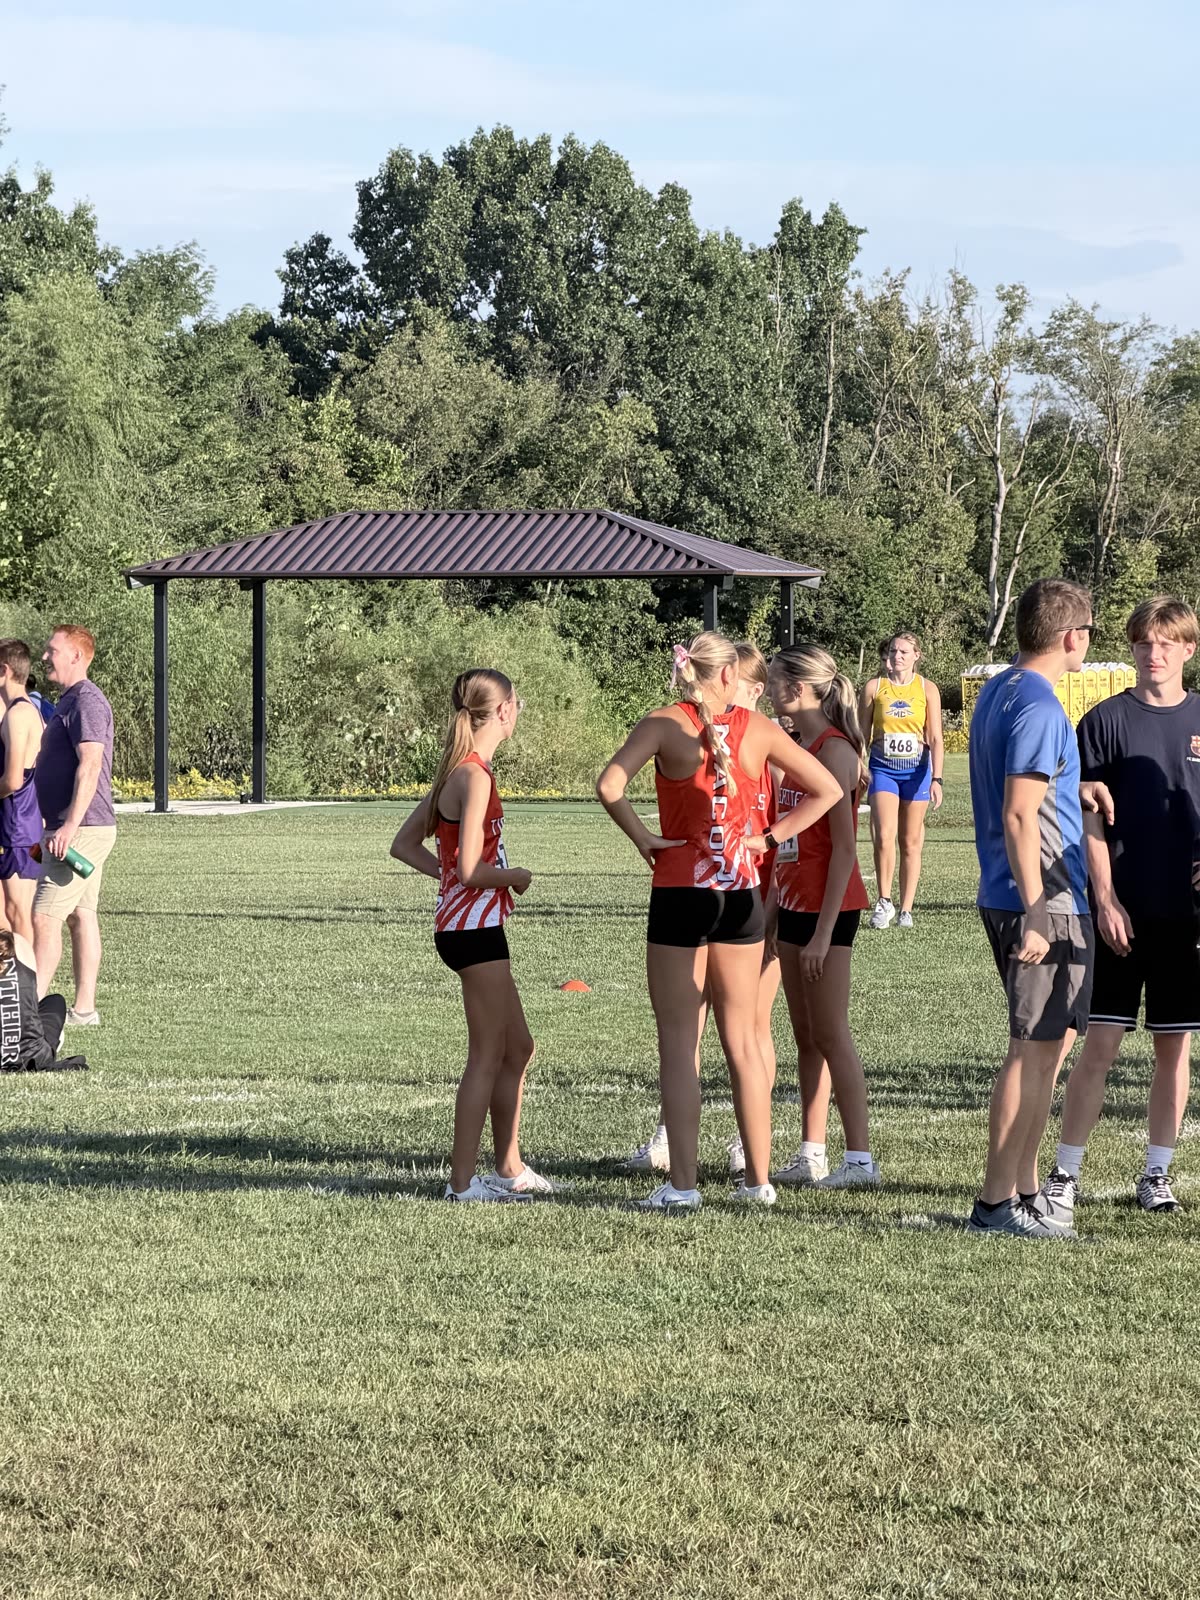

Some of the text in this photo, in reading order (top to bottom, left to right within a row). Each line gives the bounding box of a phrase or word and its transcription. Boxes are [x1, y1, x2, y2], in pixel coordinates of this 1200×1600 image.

[708, 723, 734, 882] MACON
[889, 739, 913, 753] 468
[0, 957, 21, 1070] NTHER
